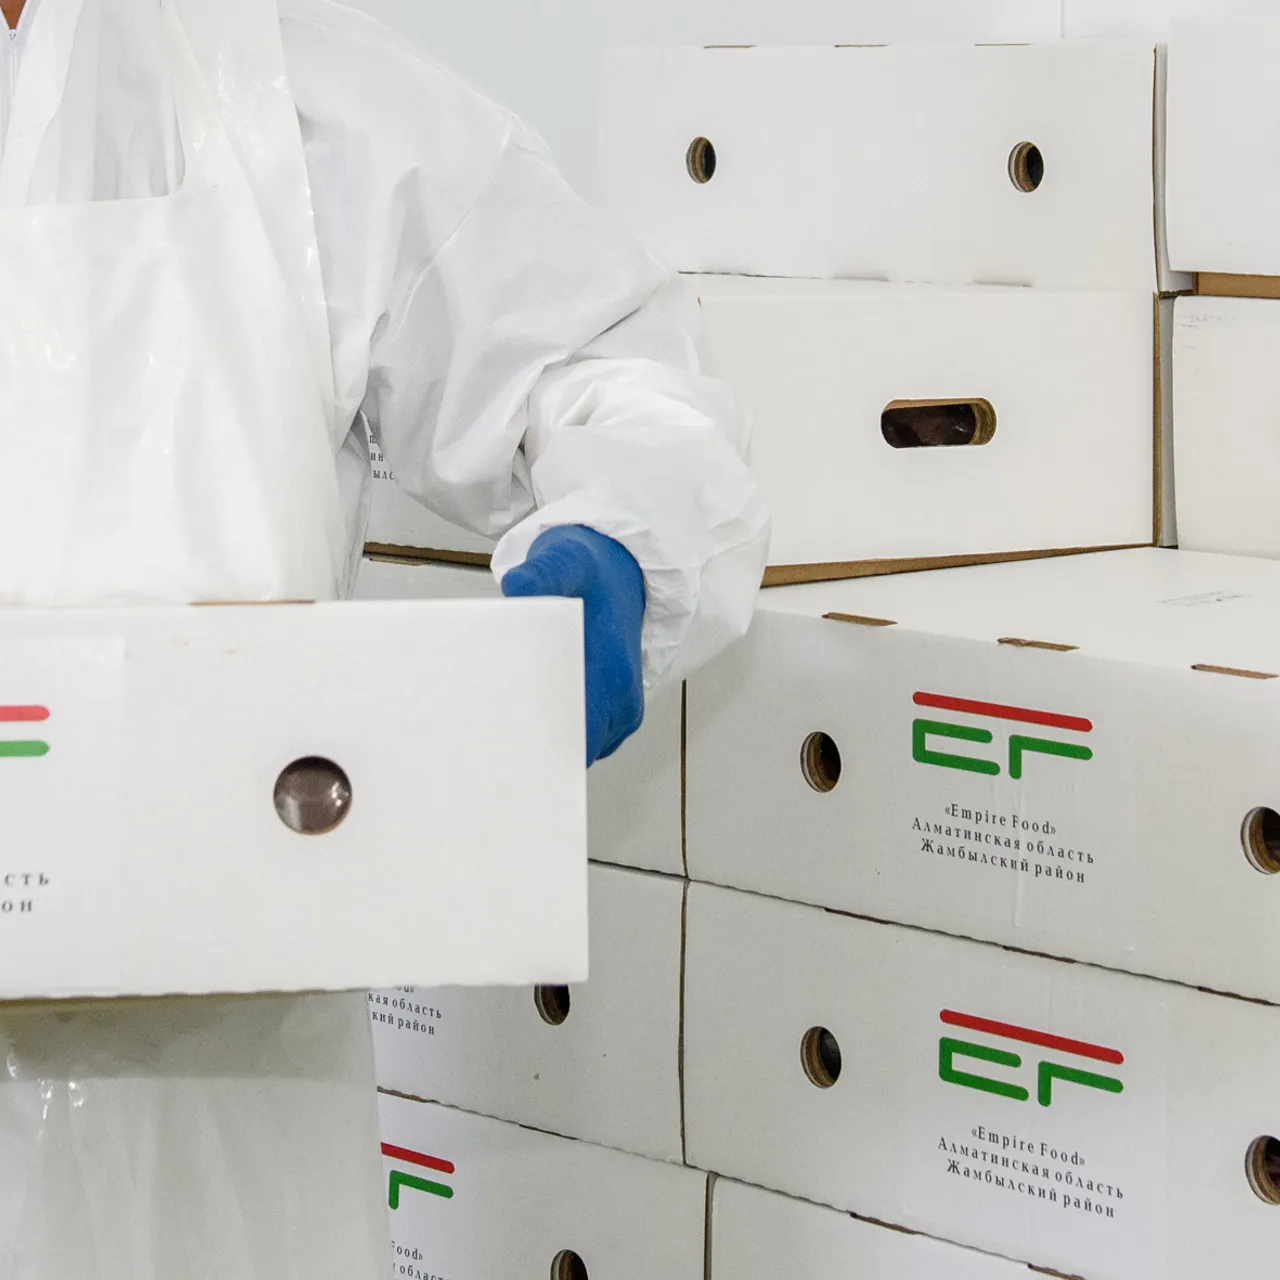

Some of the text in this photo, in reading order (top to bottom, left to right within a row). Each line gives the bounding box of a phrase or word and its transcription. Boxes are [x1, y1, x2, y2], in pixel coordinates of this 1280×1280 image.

[911, 816, 1094, 865] Алматинская область
[944, 802, 1057, 835] «Empire Food»
[920, 837, 1085, 884] Жамбылский район
[392, 998, 442, 1019] область
[397, 1017, 435, 1036] район
[971, 1125, 1086, 1166] «Empire Food»
[937, 1136, 1124, 1200] Алматинская область
[946, 1158, 1115, 1219] Жамбылский район
